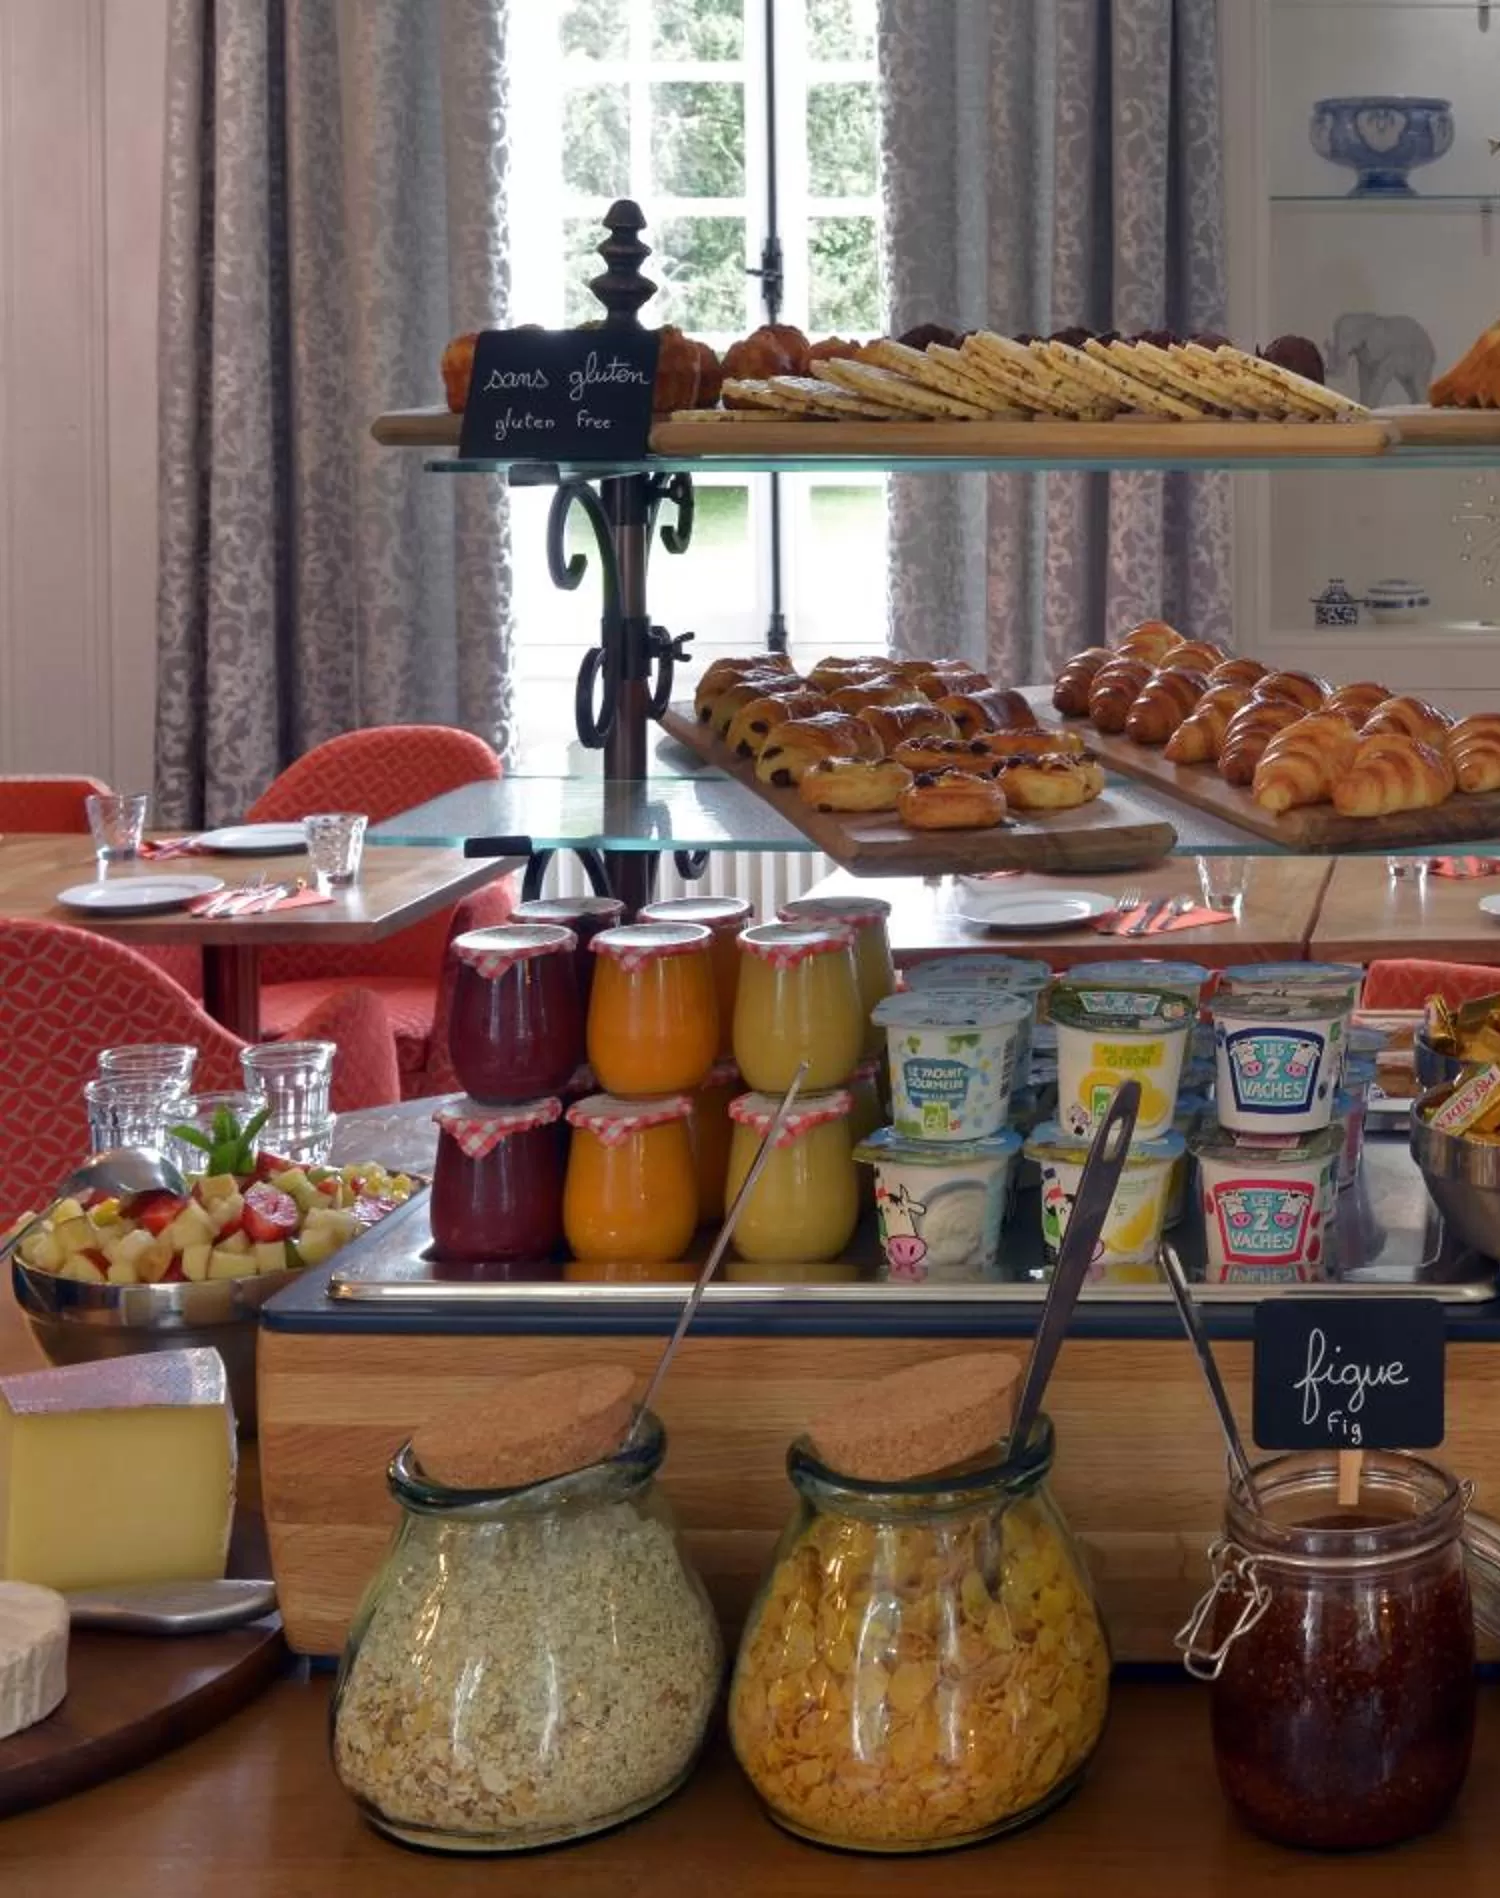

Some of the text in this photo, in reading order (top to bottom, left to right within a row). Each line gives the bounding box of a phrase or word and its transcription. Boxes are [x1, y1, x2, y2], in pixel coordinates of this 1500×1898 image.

[483, 368, 550, 391] sans
[494, 407, 556, 441] gluten
[1264, 1056, 1281, 1080] 2
[1242, 1081, 1303, 1099] VACHES
[1253, 1207, 1270, 1231] 2
[1230, 1231, 1293, 1249] VACHES
[1292, 1327, 1410, 1425] figue
